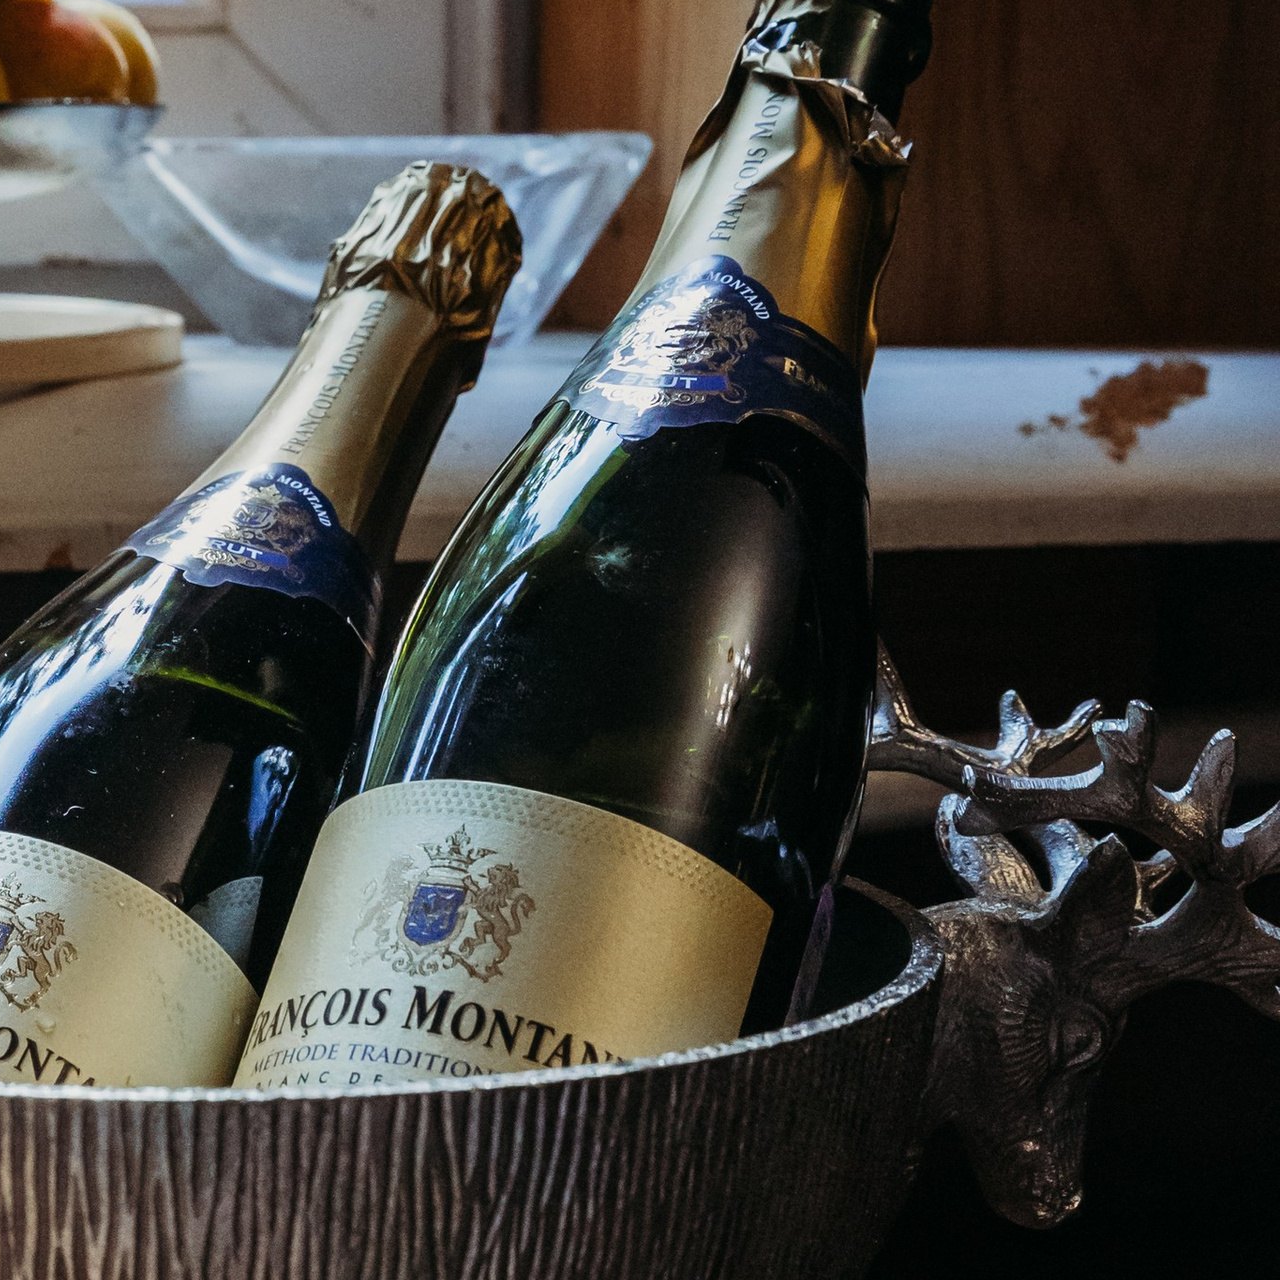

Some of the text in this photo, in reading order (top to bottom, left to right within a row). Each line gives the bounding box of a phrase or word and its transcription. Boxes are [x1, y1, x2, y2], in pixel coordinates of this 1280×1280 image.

[707, 270, 770, 321] MONTAND
[327, 299, 387, 380] MONTAND
[621, 375, 698, 389] BRUT
[276, 473, 332, 528] MONTAND
[208, 538, 264, 560] RUT
[243, 984, 626, 1068] FRANÇOIS MONTAN
[252, 1042, 341, 1077] MÉTHODE
